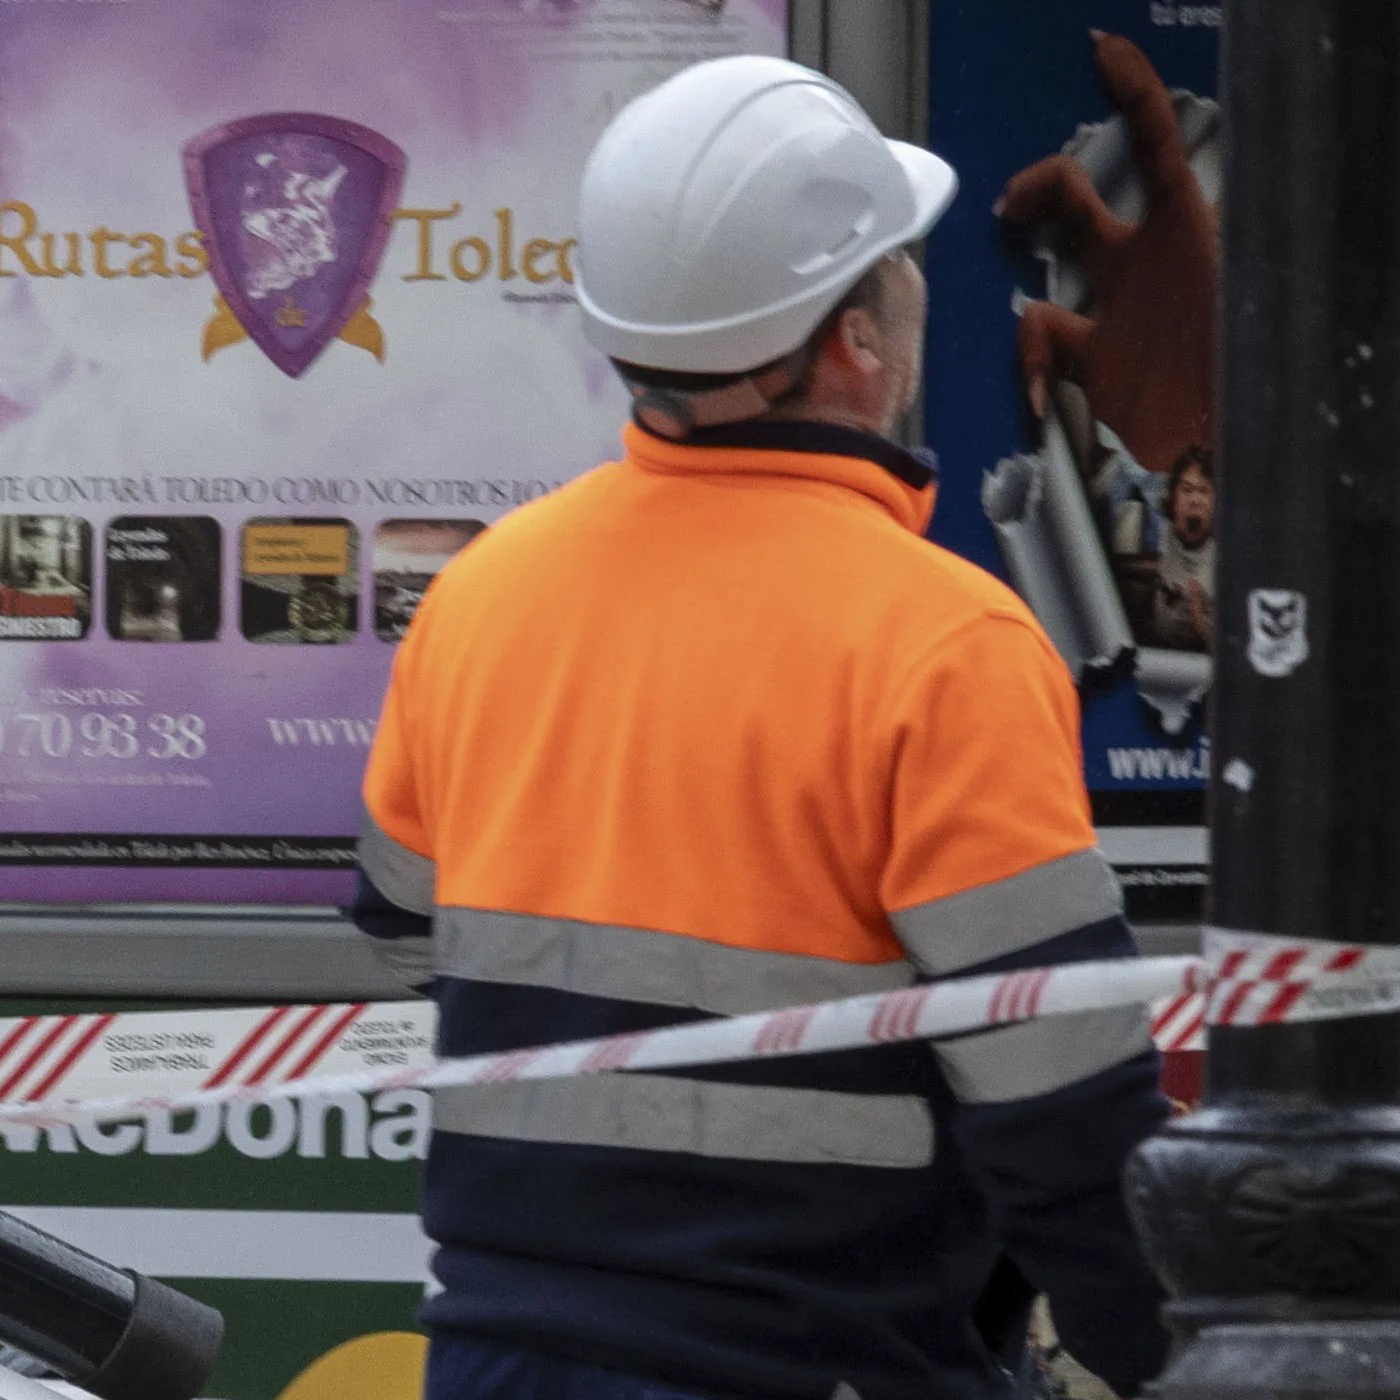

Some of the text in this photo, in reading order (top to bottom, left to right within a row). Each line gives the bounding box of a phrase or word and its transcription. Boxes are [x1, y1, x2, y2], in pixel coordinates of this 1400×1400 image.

[160, 476, 268, 505] TOLEDO
[271, 477, 359, 505] COMO
[364, 479, 508, 507] NOSOTROS
[14, 712, 73, 759] 70
[79, 712, 139, 760] 93
[147, 712, 207, 760] 38
